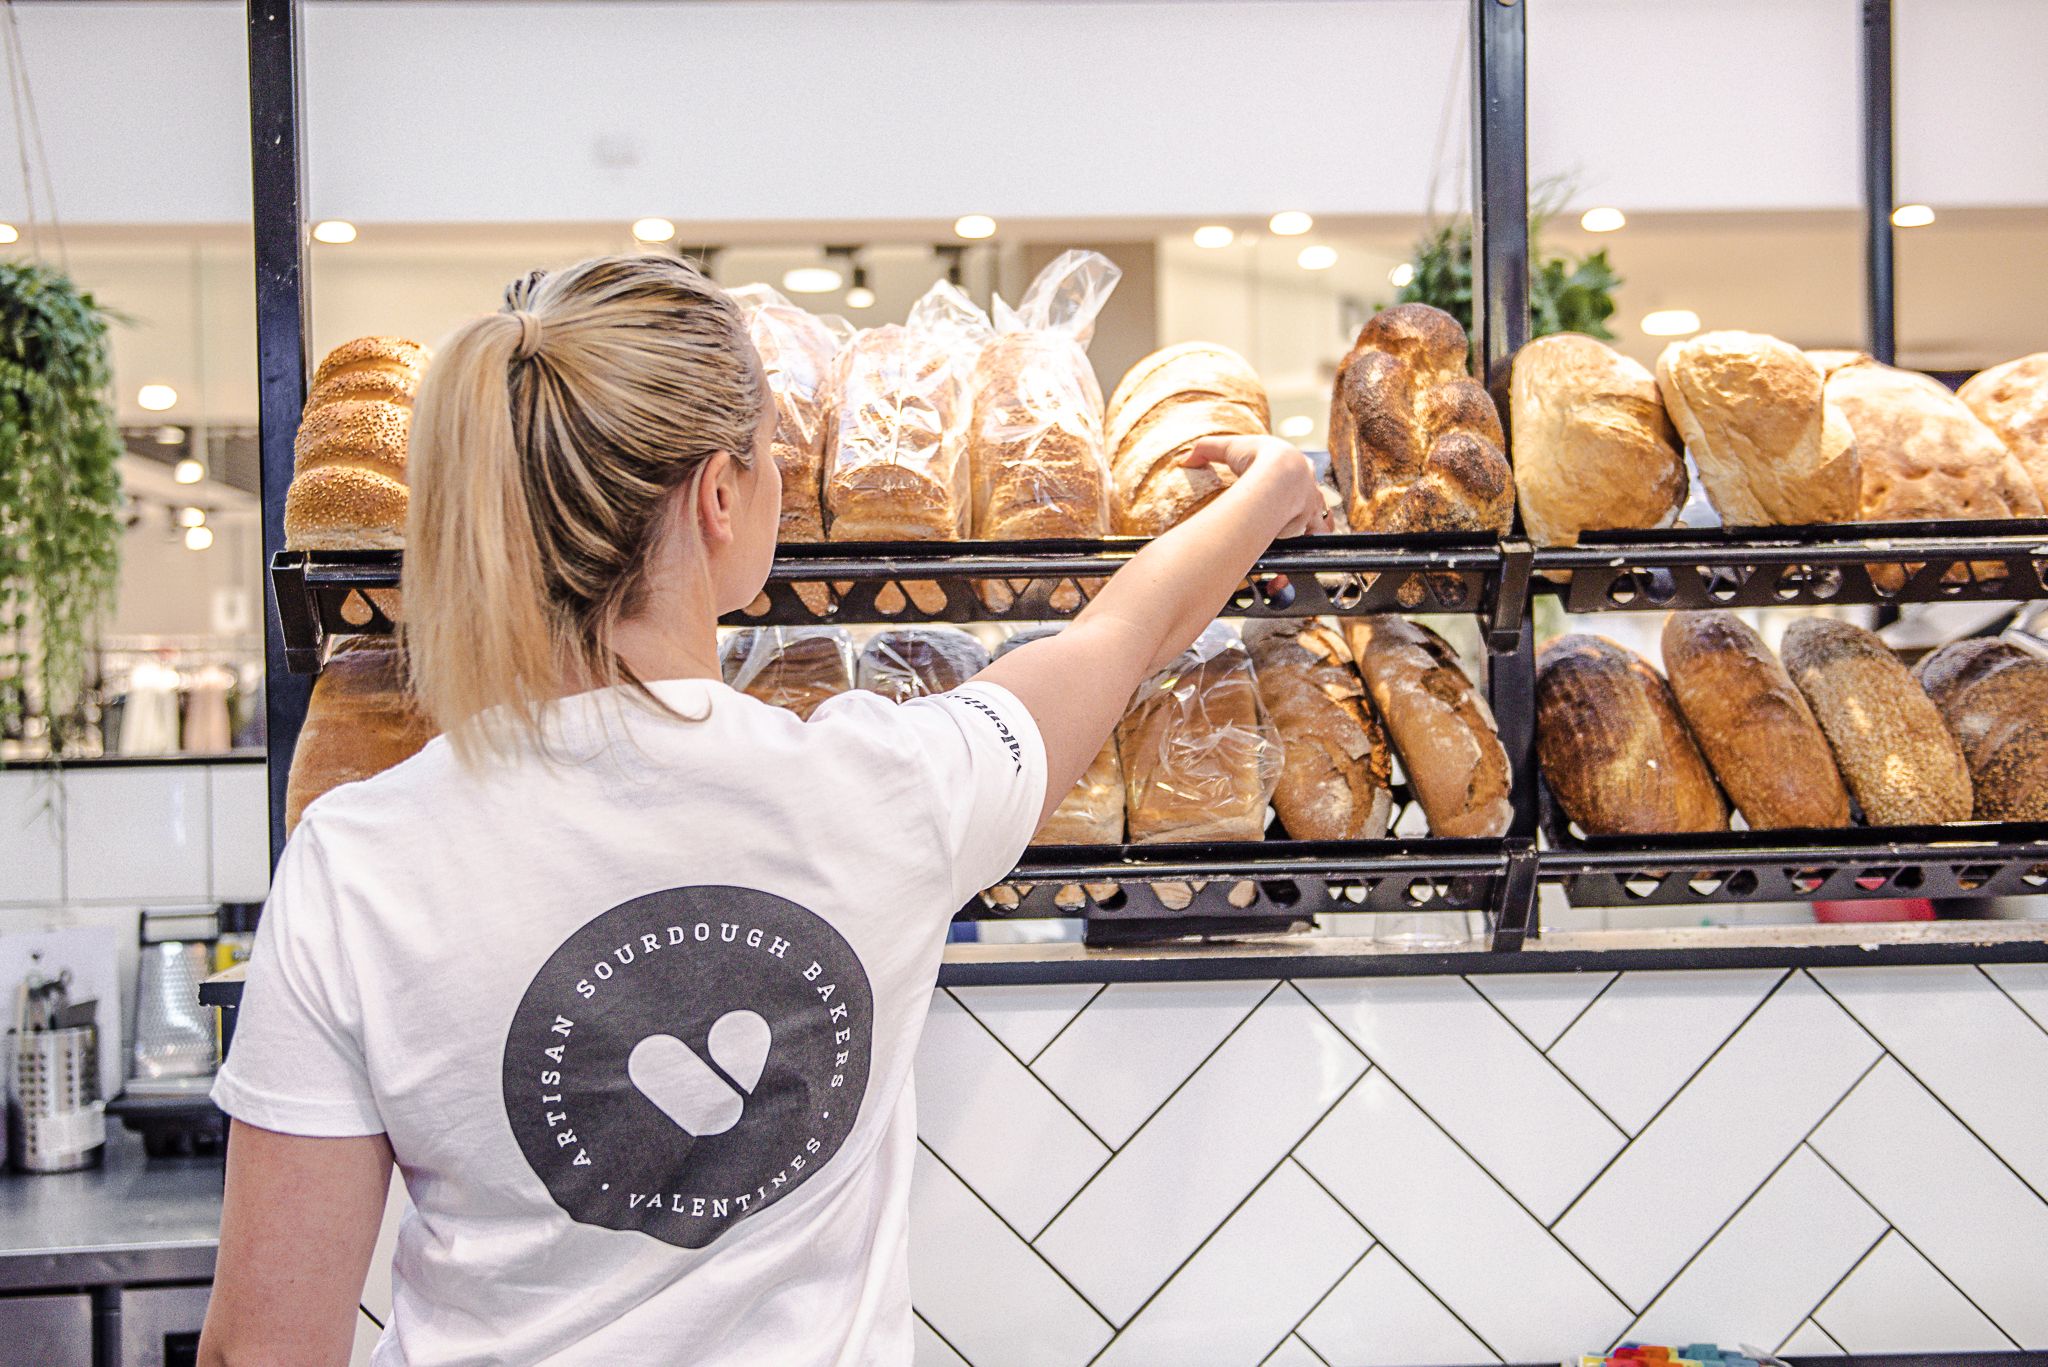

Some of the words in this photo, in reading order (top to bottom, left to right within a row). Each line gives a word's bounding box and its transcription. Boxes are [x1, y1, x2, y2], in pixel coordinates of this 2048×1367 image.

[541, 1015, 592, 1168] ARTISAN
[576, 923, 790, 998] SOURDOUGH
[803, 961, 850, 1087] BAKERS
[628, 1137, 821, 1217] VALENTINES
